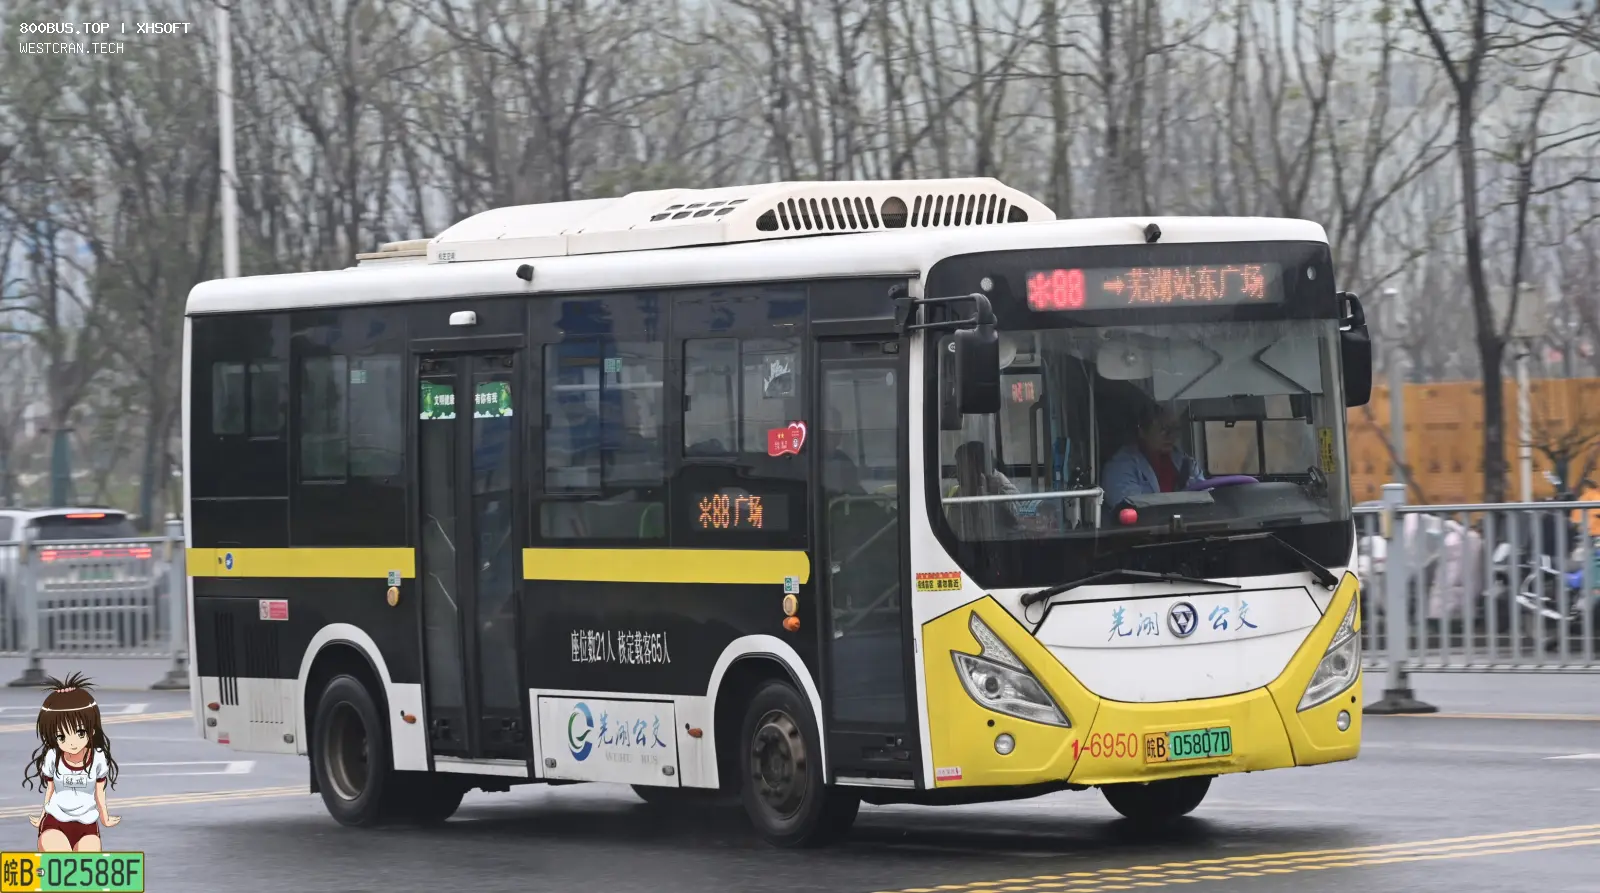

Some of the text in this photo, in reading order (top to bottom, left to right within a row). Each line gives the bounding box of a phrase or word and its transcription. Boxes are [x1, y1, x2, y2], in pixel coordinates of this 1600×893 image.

[1125, 264, 1264, 304] 芜湖站东广场
[475, 392, 498, 405] 有你有我
[1208, 600, 1258, 631] 公交
[571, 629, 671, 664] 座位数21人 核定载客65人
[597, 709, 667, 748] 芜湖公交
[1071, 732, 1139, 760] 1-6950
